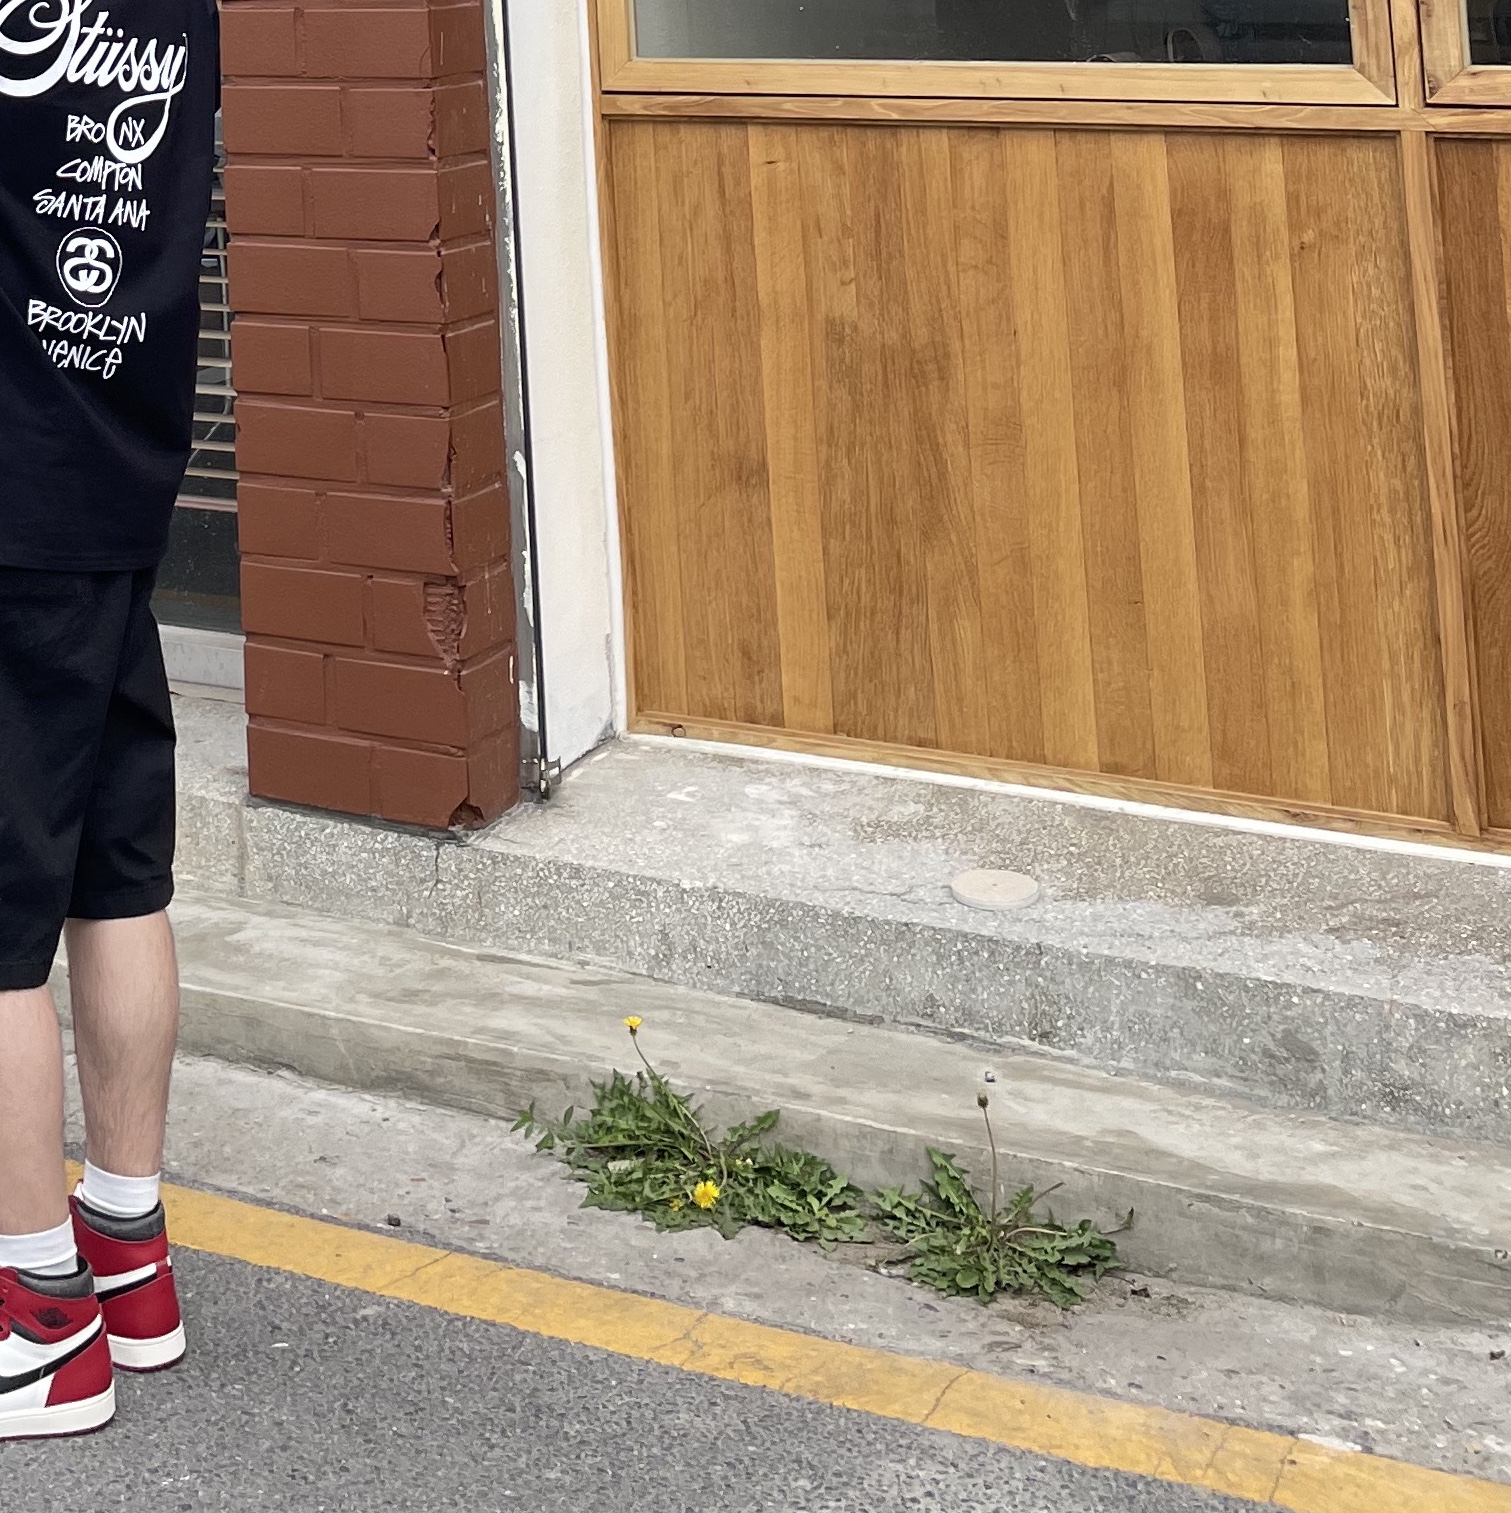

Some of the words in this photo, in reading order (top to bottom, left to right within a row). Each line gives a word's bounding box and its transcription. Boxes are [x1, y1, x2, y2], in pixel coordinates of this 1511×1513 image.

[55, 155, 143, 192] COMPTON
[32, 189, 107, 224] SANTA
[107, 197, 151, 232] ANA
[27, 298, 147, 346] BROOKLYN
